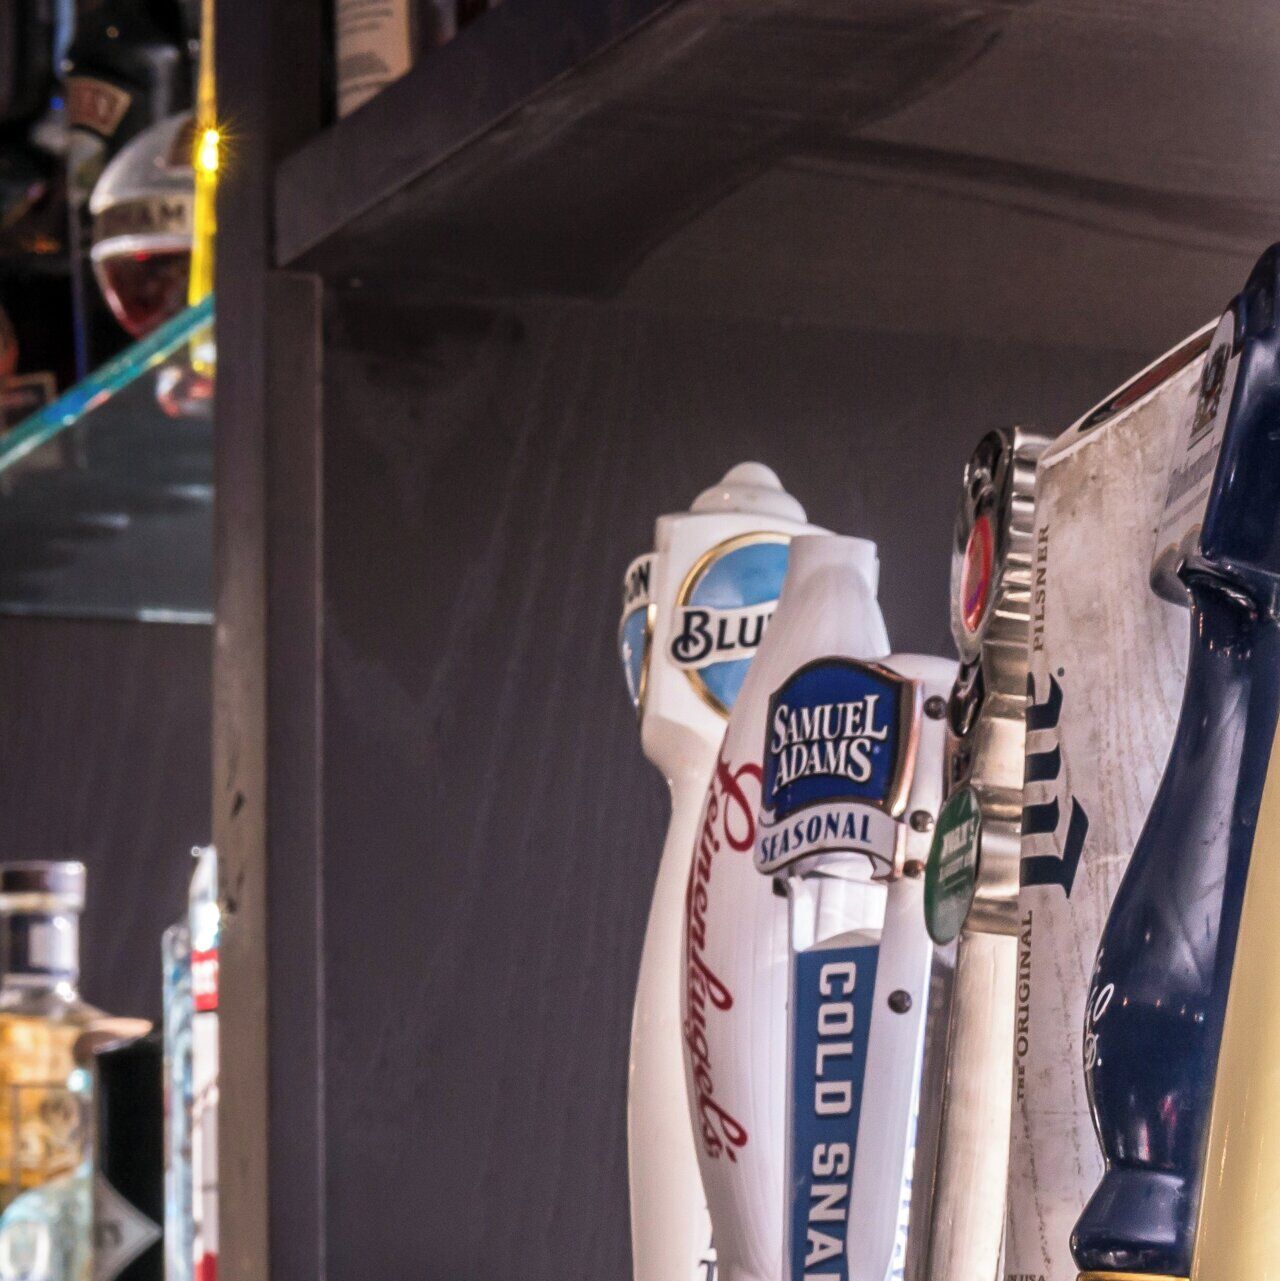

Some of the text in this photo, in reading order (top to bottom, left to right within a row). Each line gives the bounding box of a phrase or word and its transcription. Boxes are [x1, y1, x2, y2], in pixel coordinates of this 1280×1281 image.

[1033, 525, 1051, 653] PILSNER
[671, 610, 773, 663] BLU
[770, 694, 889, 753] SAMUEL
[771, 736, 874, 797] ADAMS
[760, 812, 873, 863] SEASONAL
[1016, 909, 1033, 1102] THE ORIGINAL
[814, 960, 858, 1116] COLD
